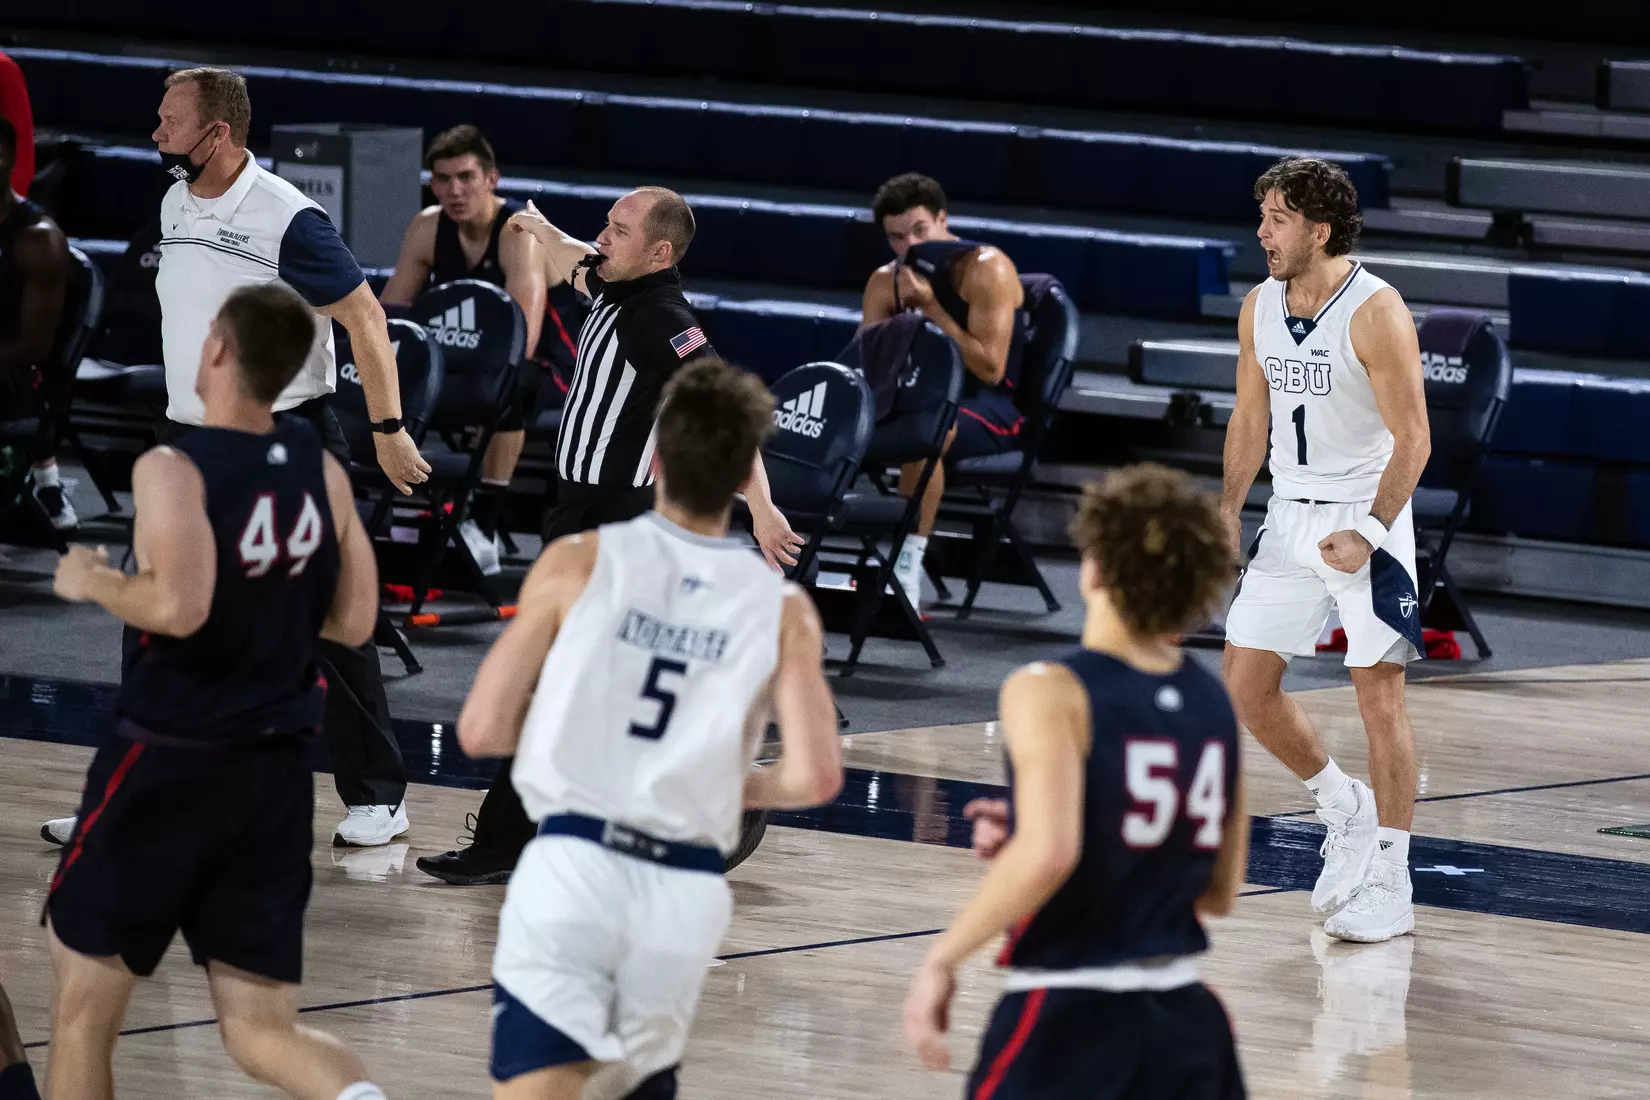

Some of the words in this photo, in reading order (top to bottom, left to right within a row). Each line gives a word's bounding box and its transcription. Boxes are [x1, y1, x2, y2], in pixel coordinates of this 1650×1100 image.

[216, 228, 250, 244] TRAILBLAZERS
[1292, 327, 1306, 335] adidas
[1310, 348, 1330, 358] WAC
[1264, 356, 1332, 396] CBU
[1292, 404, 1308, 466] 1
[237, 491, 323, 578] 44
[626, 655, 688, 741] 5
[1121, 736, 1226, 850] 54
